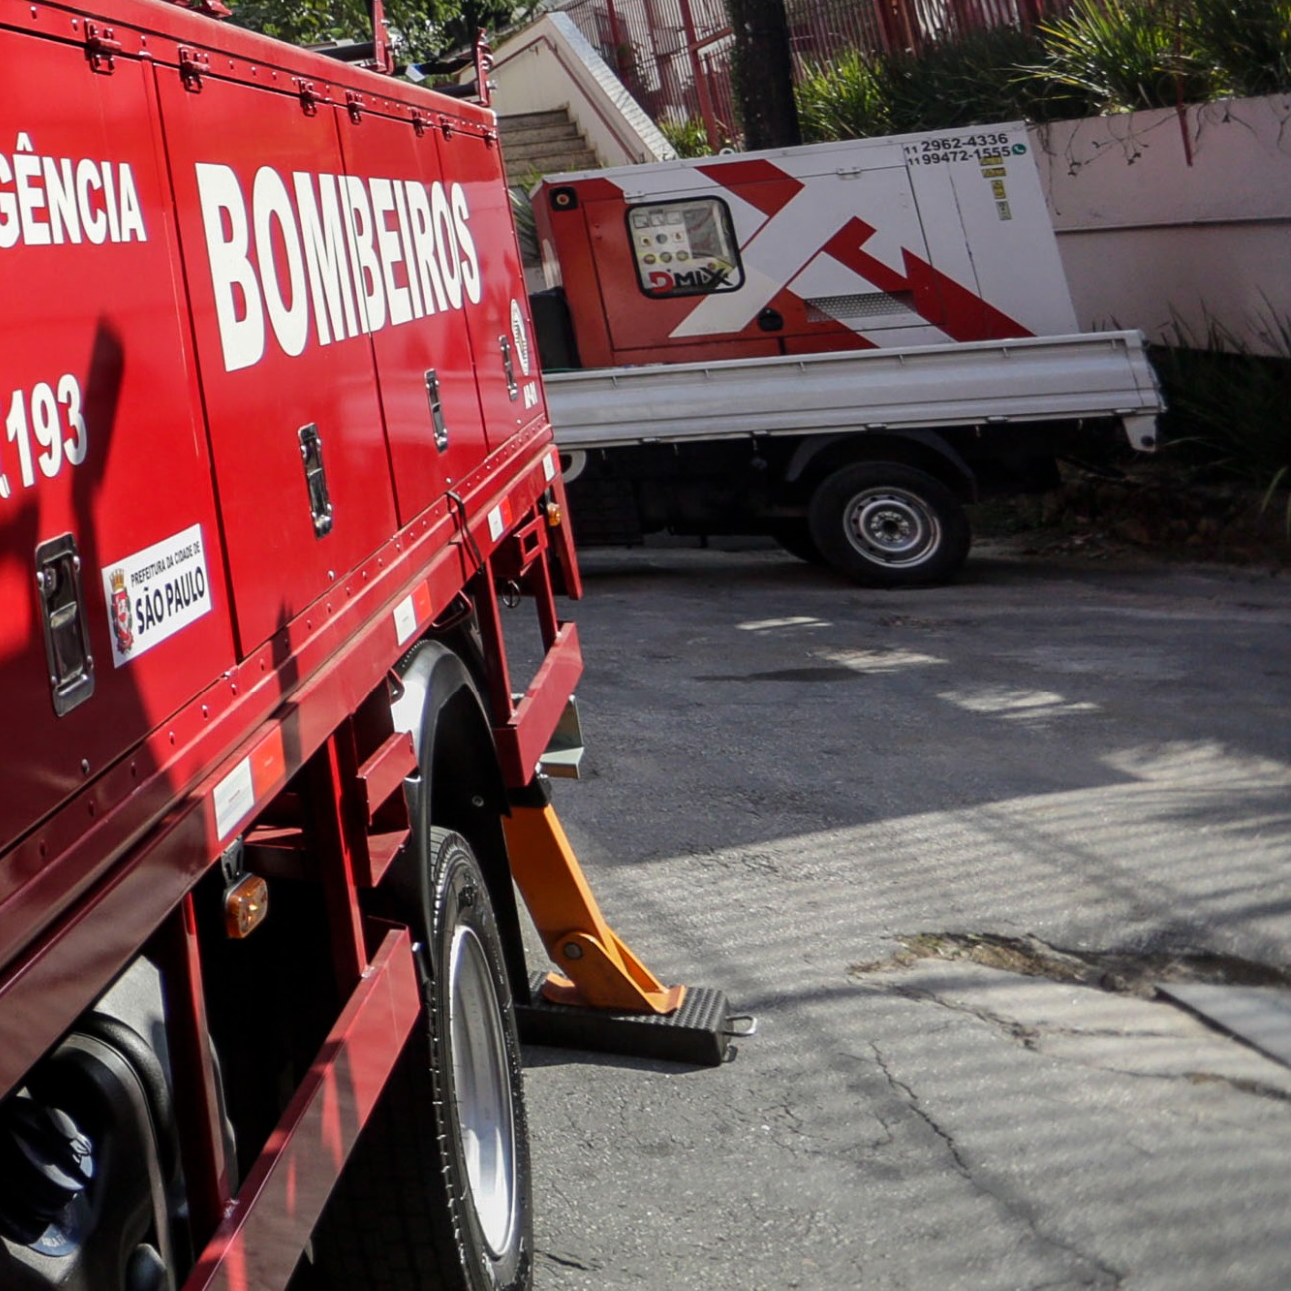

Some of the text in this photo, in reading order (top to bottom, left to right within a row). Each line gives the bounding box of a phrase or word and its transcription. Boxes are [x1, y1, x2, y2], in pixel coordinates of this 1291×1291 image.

[905, 133, 1009, 155] 11 2962-4336
[921, 146, 1011, 165] 99472-1555
[195, 163, 481, 372] BOMBEIROS
[6, 374, 87, 488] 193
[130, 541, 201, 587] PREFEITURA DA CIDADE DE
[135, 566, 205, 635] SÃO PAULO
